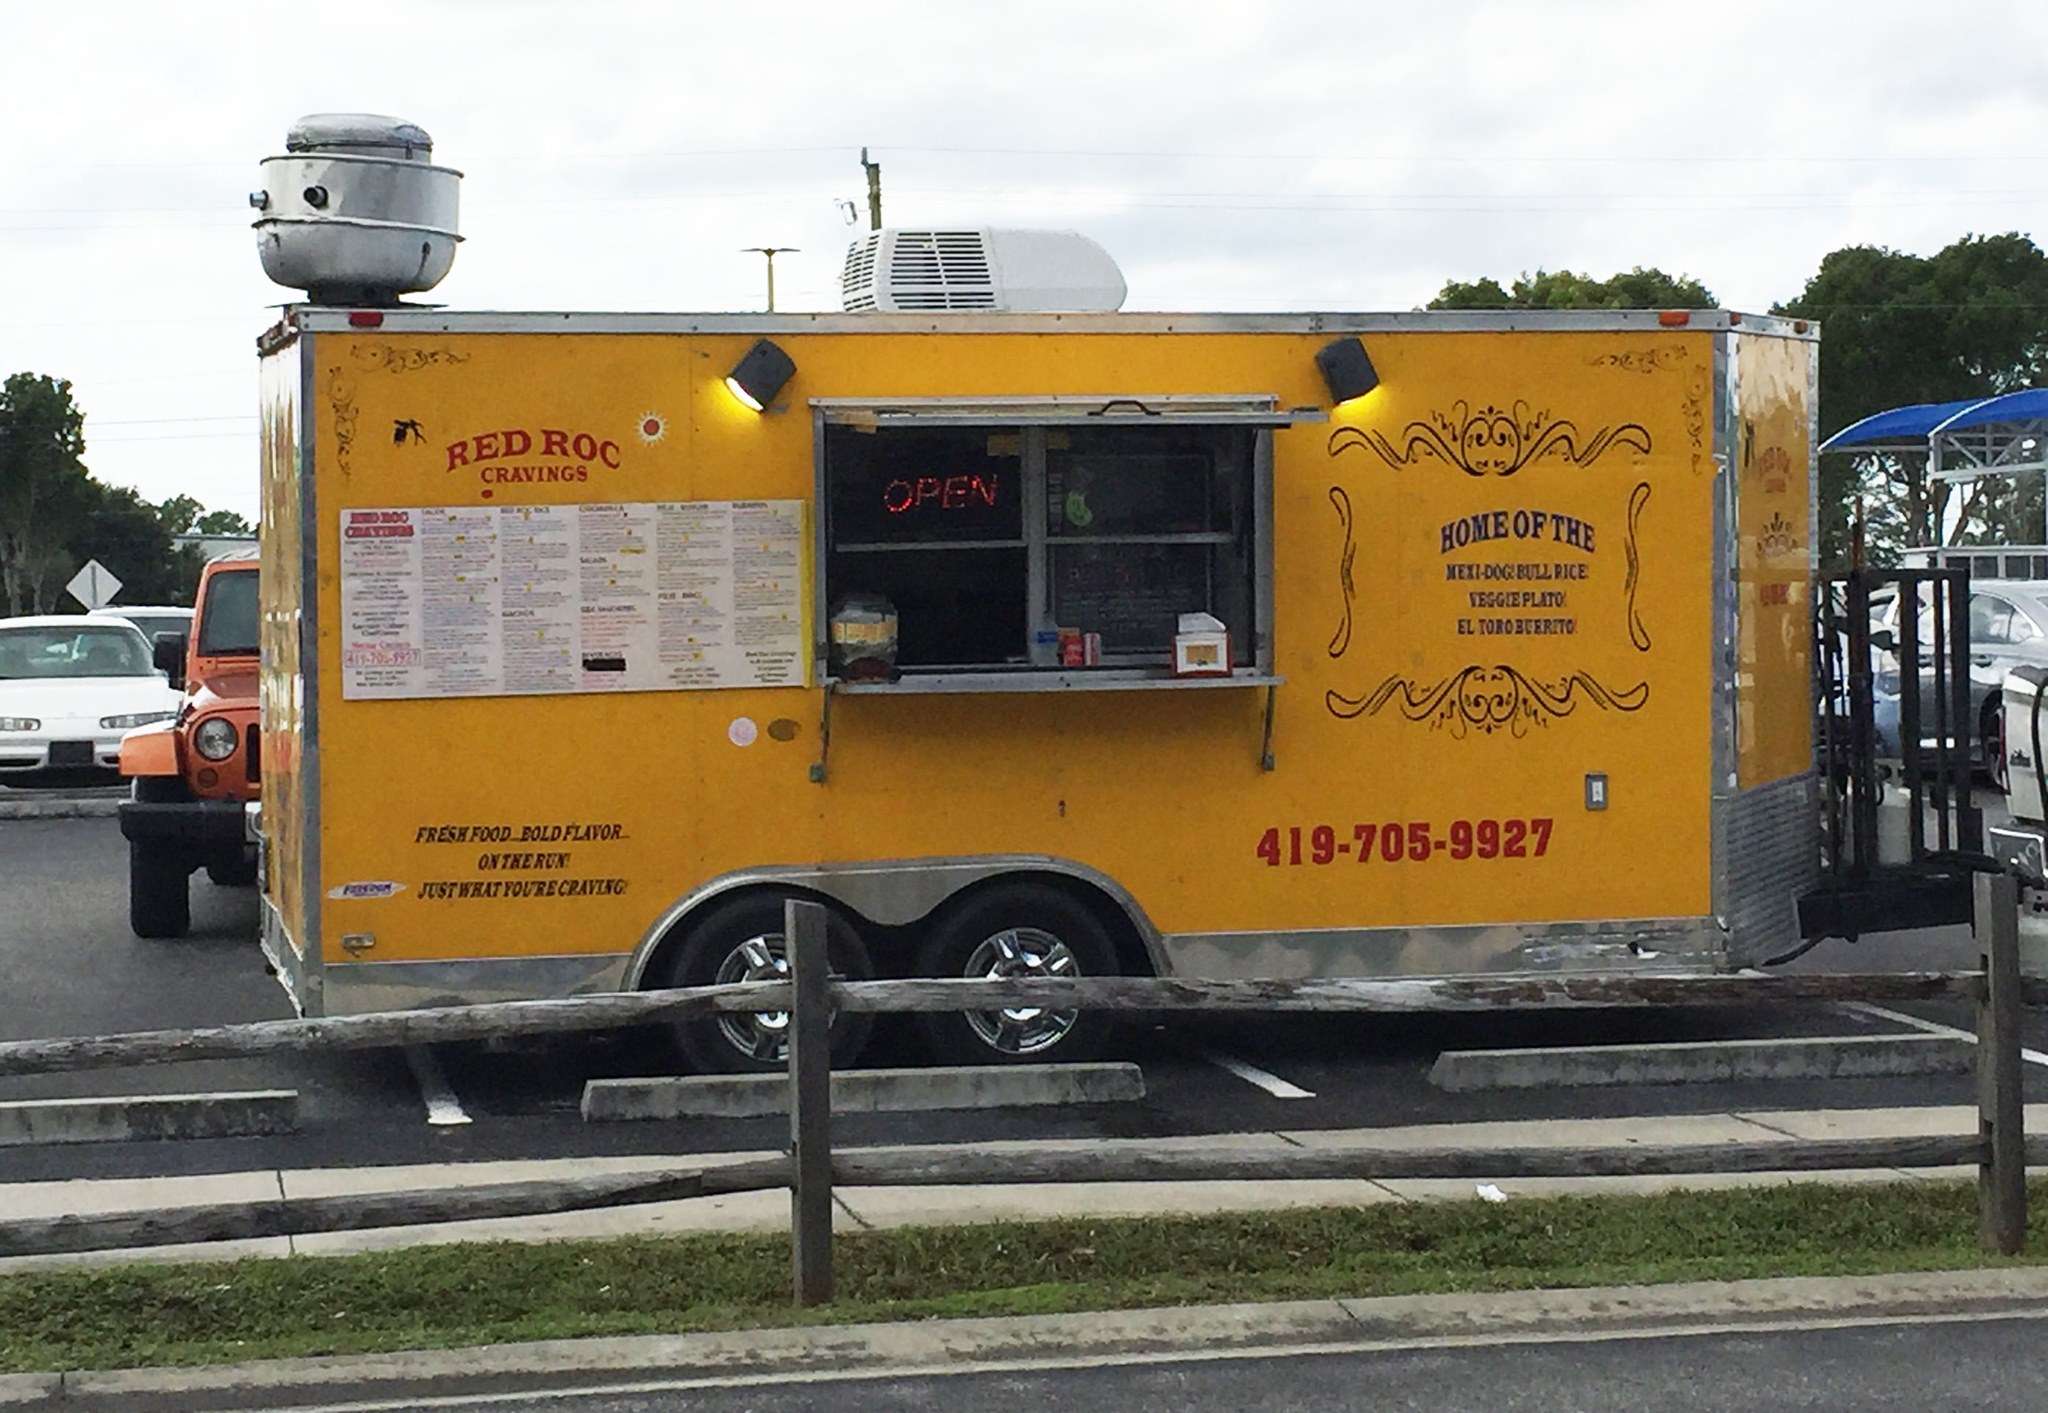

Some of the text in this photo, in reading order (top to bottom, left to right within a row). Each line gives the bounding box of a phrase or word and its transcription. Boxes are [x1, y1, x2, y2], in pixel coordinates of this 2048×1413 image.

[446, 429, 621, 473] RED ROC
[480, 465, 588, 484] CRAVINGS
[883, 473, 999, 514] OPEN
[1440, 510, 1595, 554] HOME OF THE
[1517, 563, 1551, 580] BULL
[1469, 591, 1520, 608] VEGGIE
[1457, 618, 1475, 635] EL
[1478, 618, 1515, 635] TORO
[415, 825, 470, 843] FRESH
[520, 825, 562, 842] BOLD
[1256, 818, 1554, 866] 419-705-9927
[478, 853, 502, 870] ON
[502, 853, 534, 869] THE
[417, 882, 458, 899] JUST
[458, 882, 503, 898] WHAT
